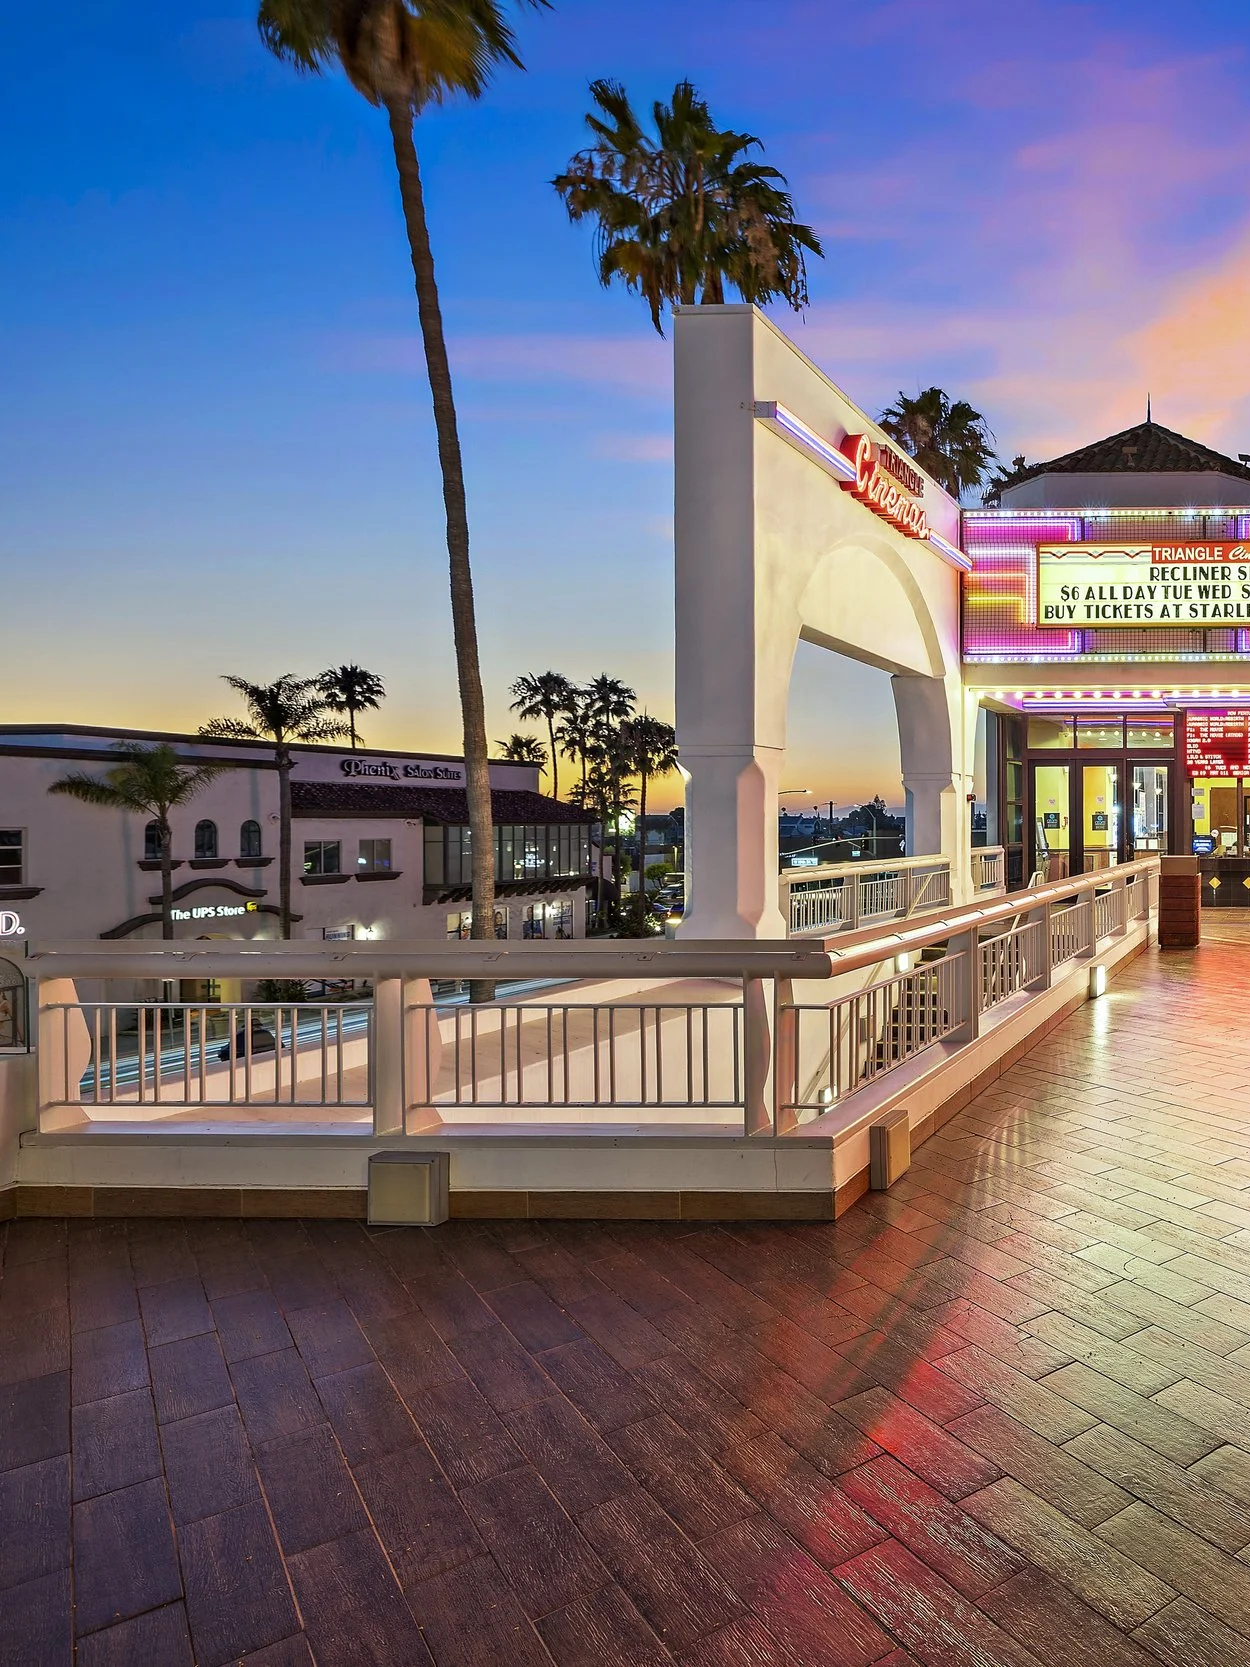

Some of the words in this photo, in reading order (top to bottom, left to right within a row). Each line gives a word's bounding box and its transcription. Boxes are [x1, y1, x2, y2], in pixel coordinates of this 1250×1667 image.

[884, 444, 924, 498] TRIANGLE
[852, 433, 931, 540] Cinemas
[1152, 547, 1223, 561] TRIANGLE
[1150, 566, 1231, 581] RECLINER
[1060, 585, 1080, 602] $6
[1085, 585, 1119, 600] ALL
[1122, 585, 1157, 600] DAY
[1161, 585, 1192, 600] TUE
[1197, 584, 1232, 600] WED
[1044, 604, 1076, 619] BUY
[1084, 603, 1153, 619] TICKETS
[1160, 603, 1183, 618] AT
[340, 759, 401, 781] Phenix
[171, 908, 191, 921] The
[191, 906, 216, 919] UPS
[216, 904, 246, 917] Store
